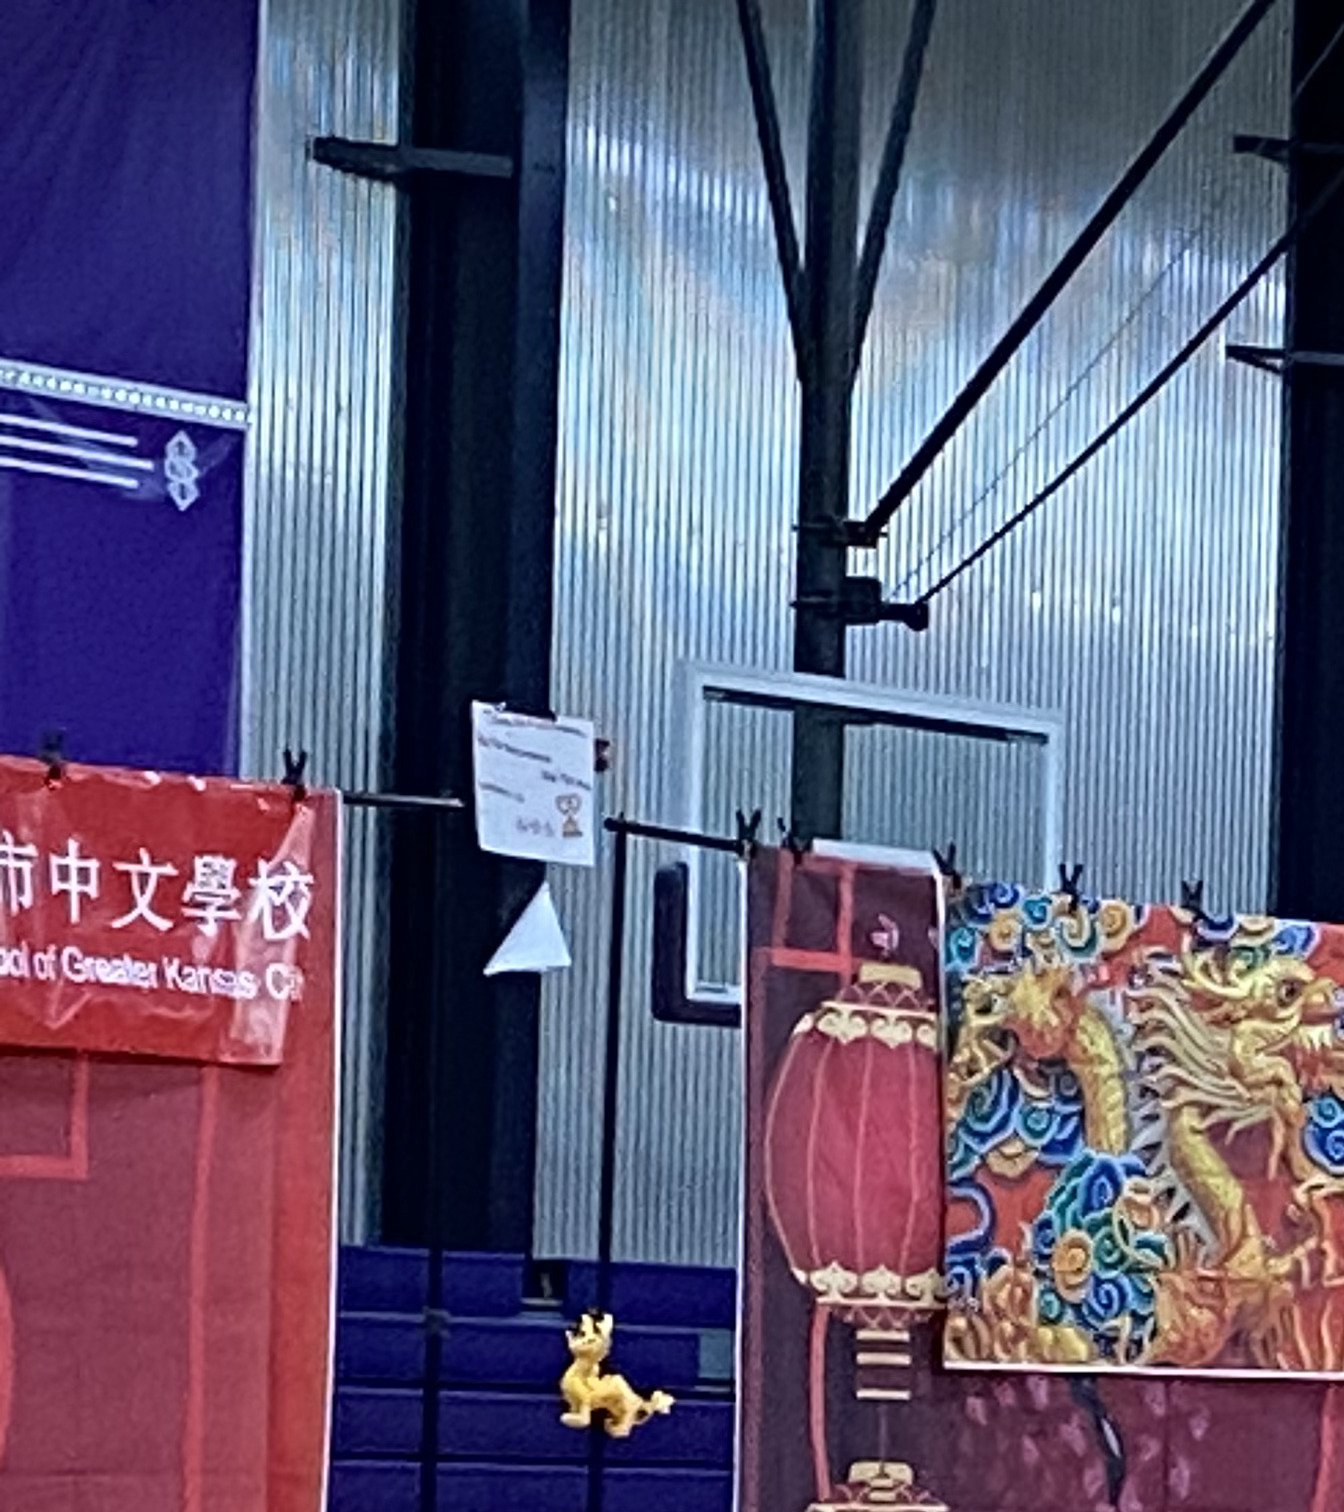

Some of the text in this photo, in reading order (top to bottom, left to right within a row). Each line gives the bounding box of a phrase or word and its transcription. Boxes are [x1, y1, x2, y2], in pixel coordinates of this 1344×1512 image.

[34, 945, 57, 980] of
[61, 946, 158, 989] Greater
[162, 956, 260, 1000] Kansas
